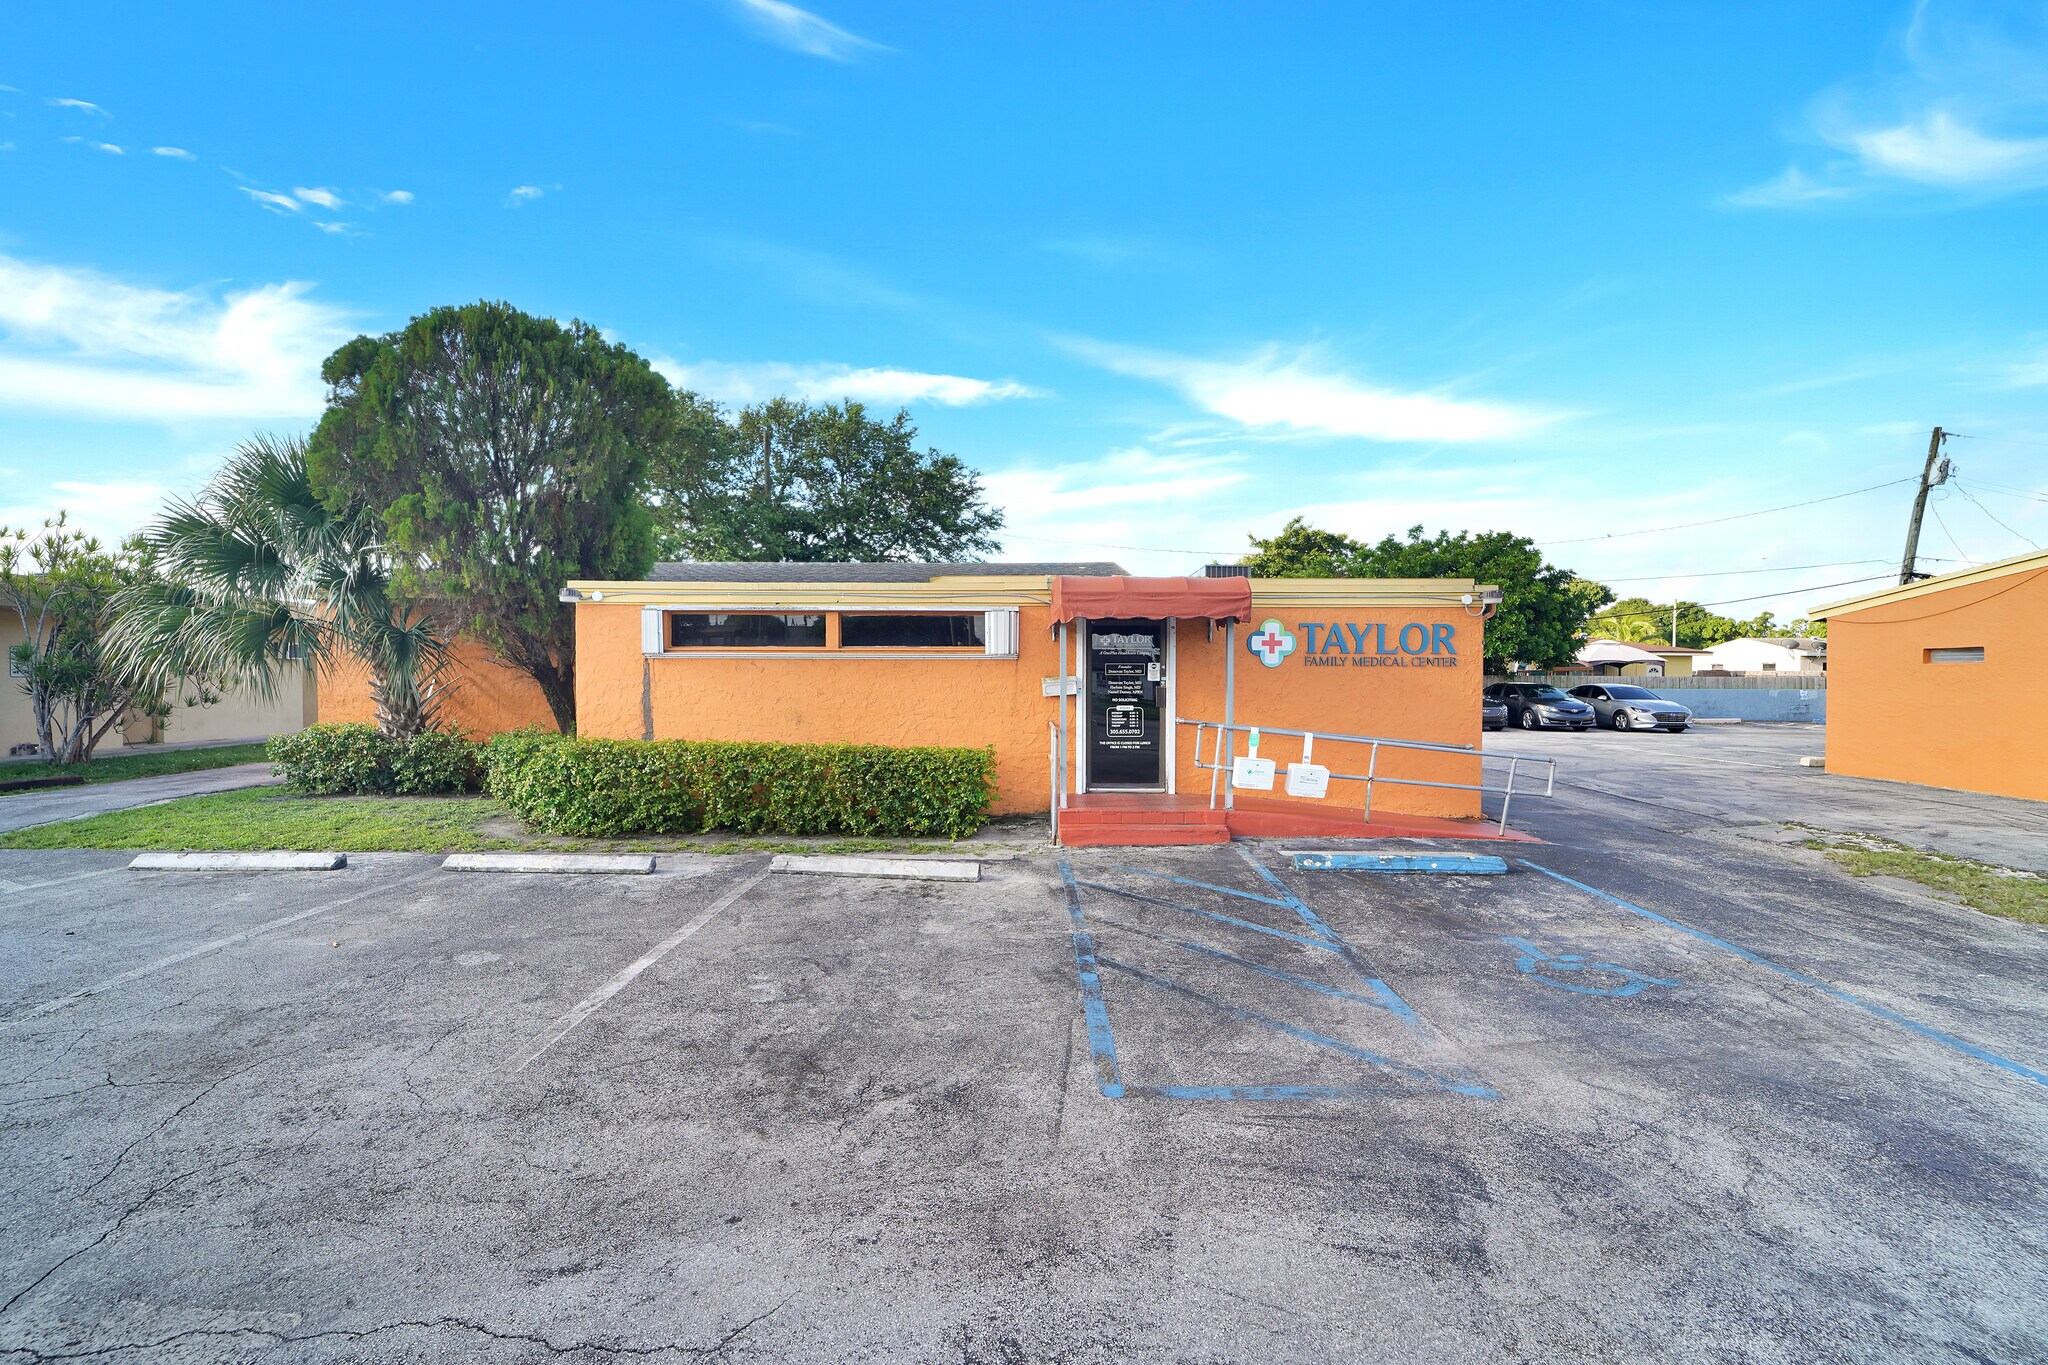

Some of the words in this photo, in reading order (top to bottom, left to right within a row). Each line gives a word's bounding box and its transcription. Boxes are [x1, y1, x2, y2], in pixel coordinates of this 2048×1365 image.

[1113, 634, 1151, 644] TAYLOR
[1299, 622, 1457, 655] TAYLOR
[1304, 656, 1348, 667] FAMILY
[1352, 656, 1408, 667] MEDICAL
[1411, 656, 1458, 667] CENTER
